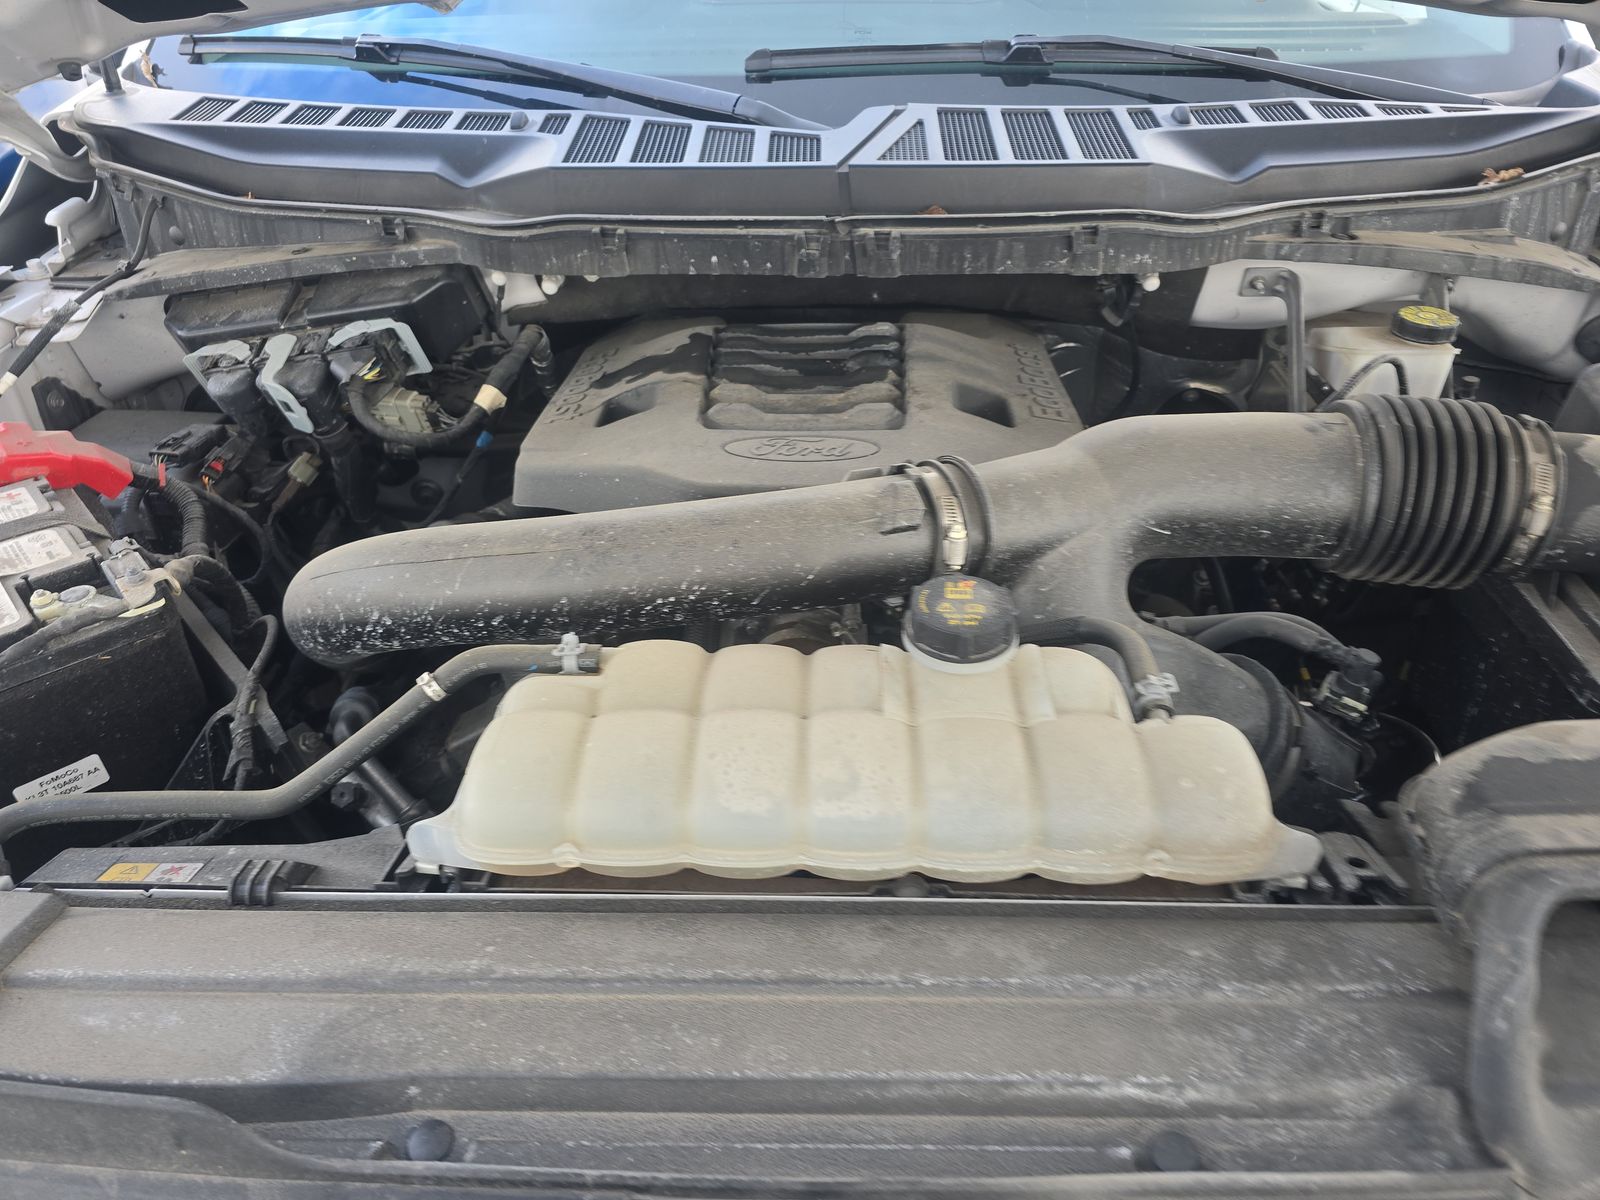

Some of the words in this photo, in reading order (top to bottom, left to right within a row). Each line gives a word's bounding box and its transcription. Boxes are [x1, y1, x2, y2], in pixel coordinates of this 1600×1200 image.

[751, 437, 855, 458] Ford
[39, 767, 79, 788] FoMoCo
[86, 766, 100, 776] AA
[54, 784, 82, 796] 500L
